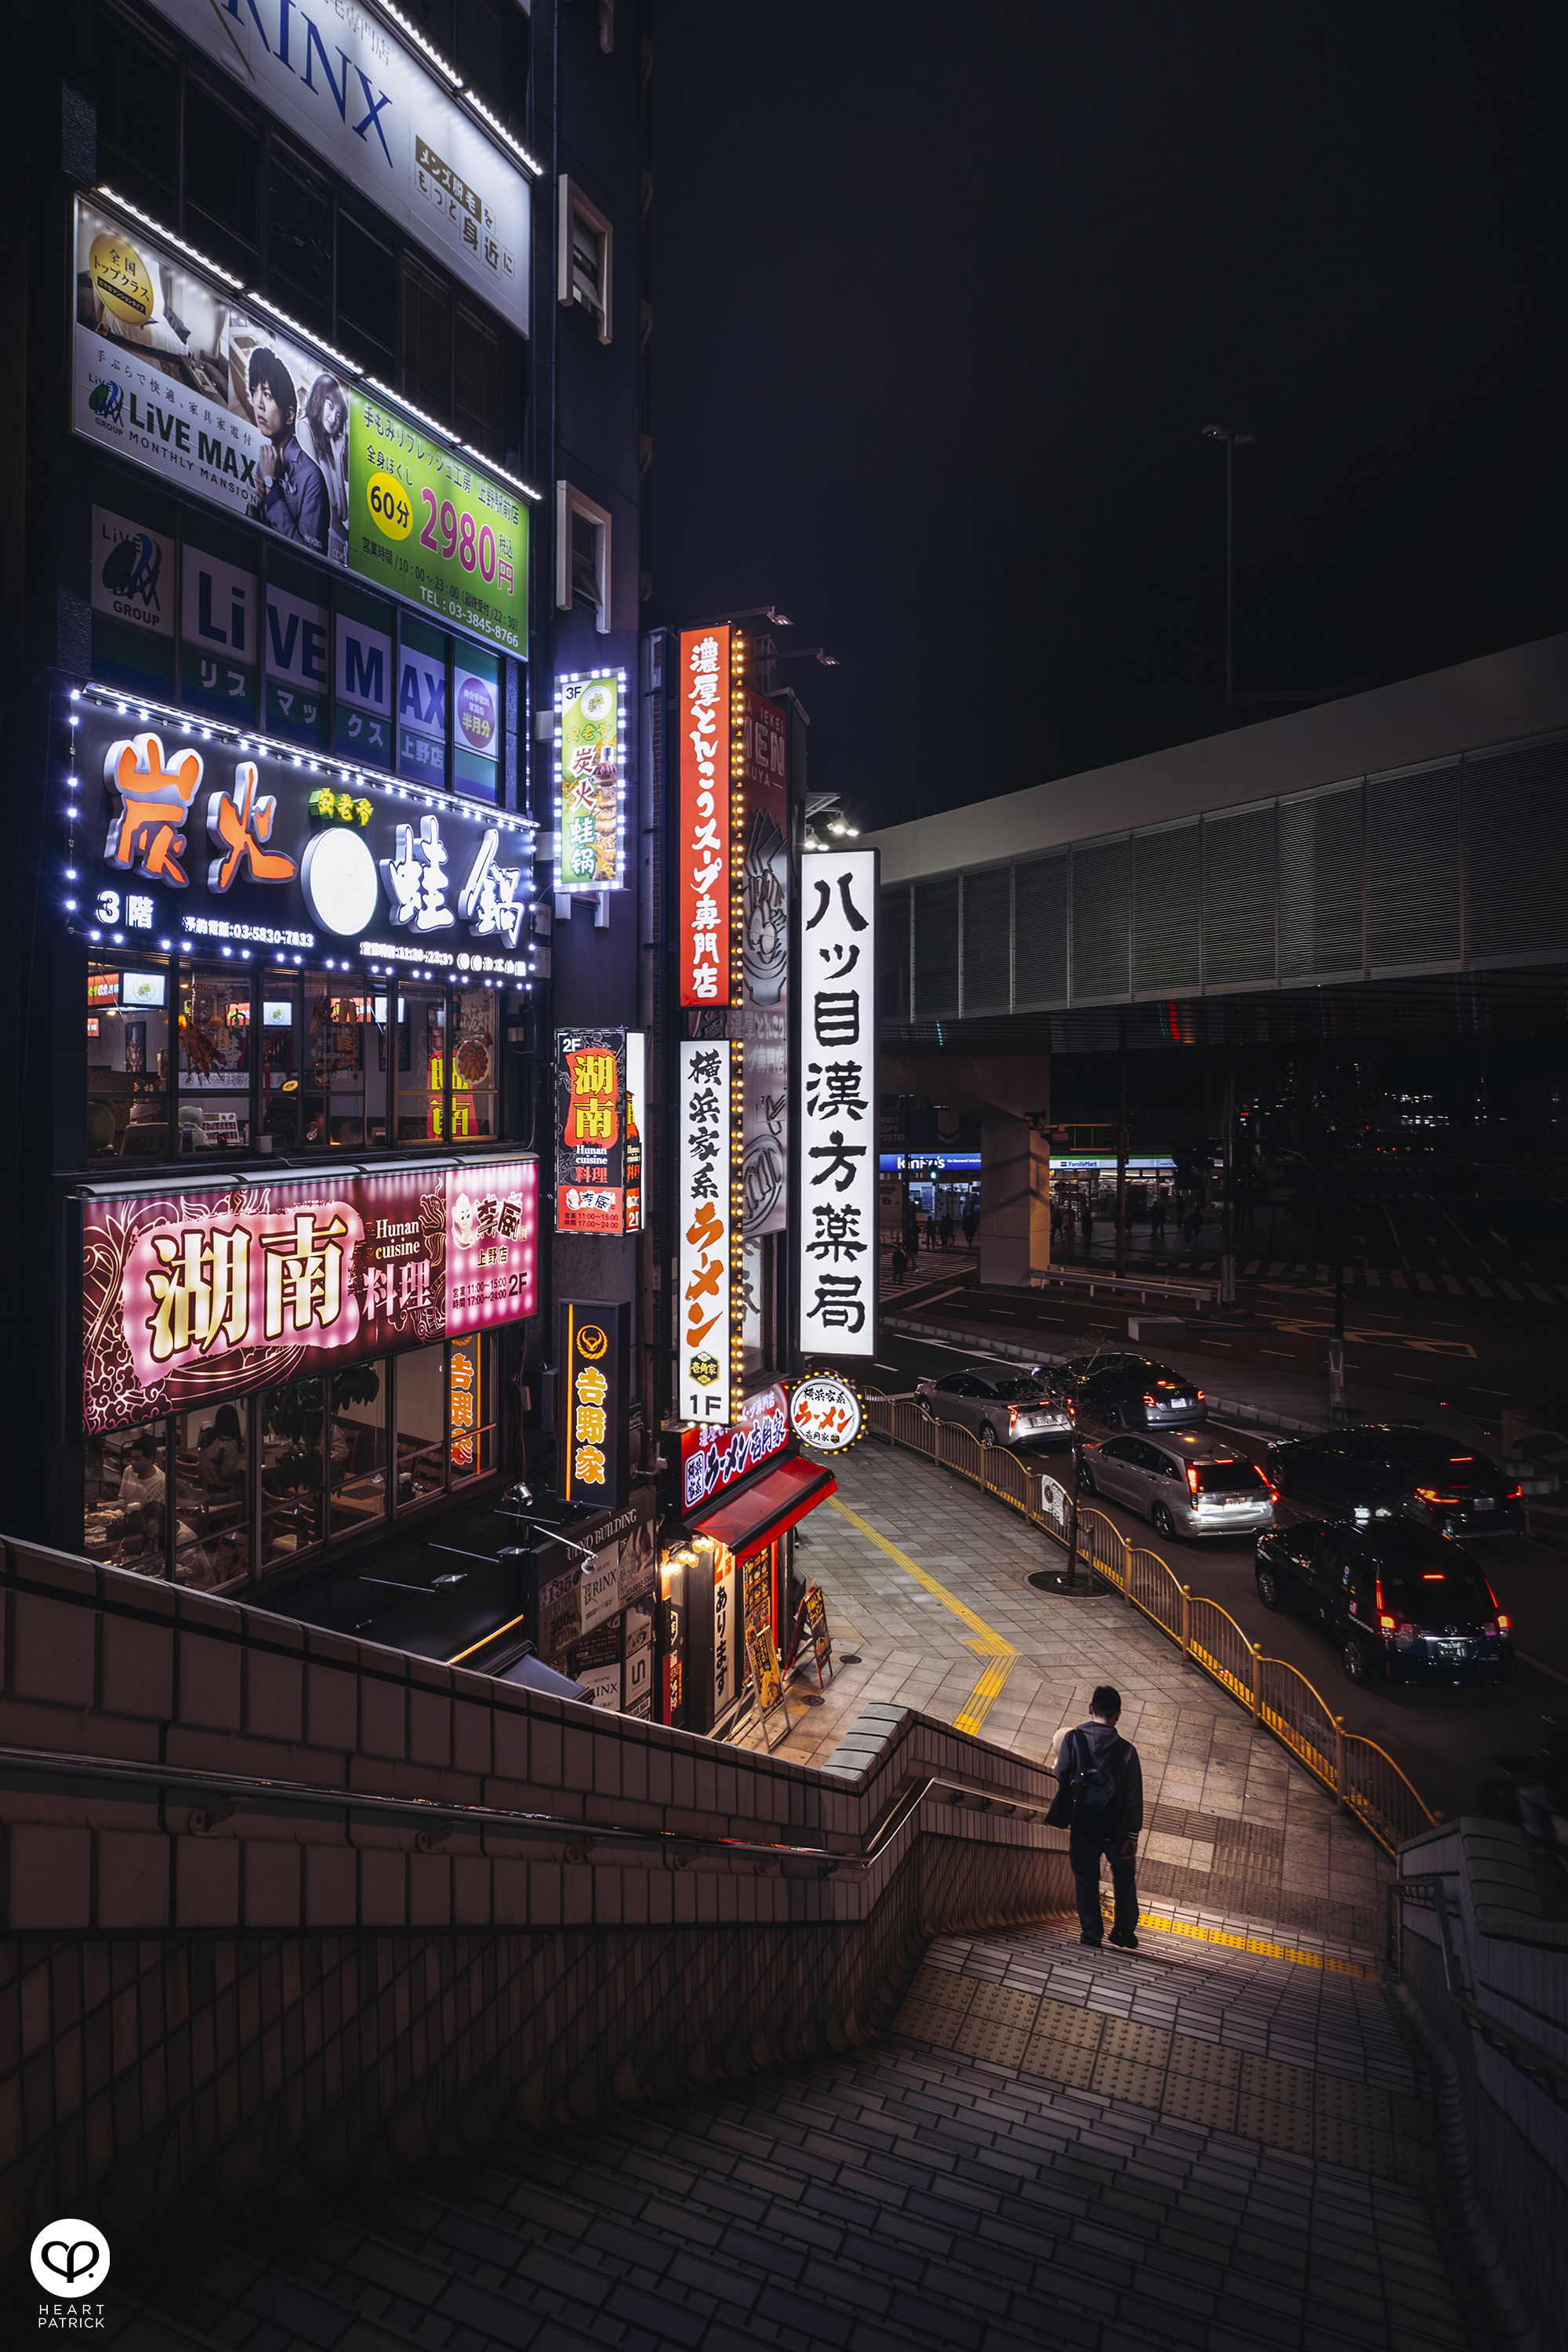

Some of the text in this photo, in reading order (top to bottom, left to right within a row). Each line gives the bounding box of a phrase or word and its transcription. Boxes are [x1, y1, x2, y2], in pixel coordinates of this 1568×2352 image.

[109, 249, 136, 277] 全国
[94, 255, 150, 302] トップクラス
[95, 417, 123, 436] GROUP
[129, 430, 257, 504] MONTHLY MANSION
[198, 430, 256, 489] MAX
[364, 404, 519, 527] 手もみリフレッシュ工房 上野駅前店
[366, 445, 412, 486] 全身ほぐし
[370, 485, 409, 528] 60分
[499, 533, 514, 560] 税込
[113, 601, 161, 626] GROUP
[346, 636, 447, 730] MAX
[566, 686, 582, 699] 3F
[463, 712, 491, 738] 半月分
[401, 735, 445, 770] 上野店
[105, 734, 298, 893] 炭火
[688, 637, 722, 998] 濃厚とんこつスープ専門店
[96, 891, 154, 929] 3階
[562, 1038, 581, 1052] 2F
[573, 1054, 615, 1138] 湖南
[575, 1155, 608, 1164] cuisine
[576, 1145, 608, 1156] Hunan
[575, 1166, 608, 1183] 料理
[376, 1218, 420, 1241] Hunan
[375, 1239, 421, 1261] cuisine
[477, 1247, 508, 1267] 上野店
[149, 1213, 348, 1362] 湖南
[362, 1258, 432, 1321] 料理
[508, 1272, 528, 1298] 2F
[690, 1362, 717, 1374] 壱角家
[690, 1394, 721, 1416] 1F
[804, 1387, 846, 1404] 横浜家系
[575, 1366, 608, 1484] 吉野家
[795, 1400, 855, 1433] ラーメン
[805, 1431, 829, 1443] 壱角家
[593, 1508, 637, 1546] BUILDING
[715, 1585, 728, 1697] あります
